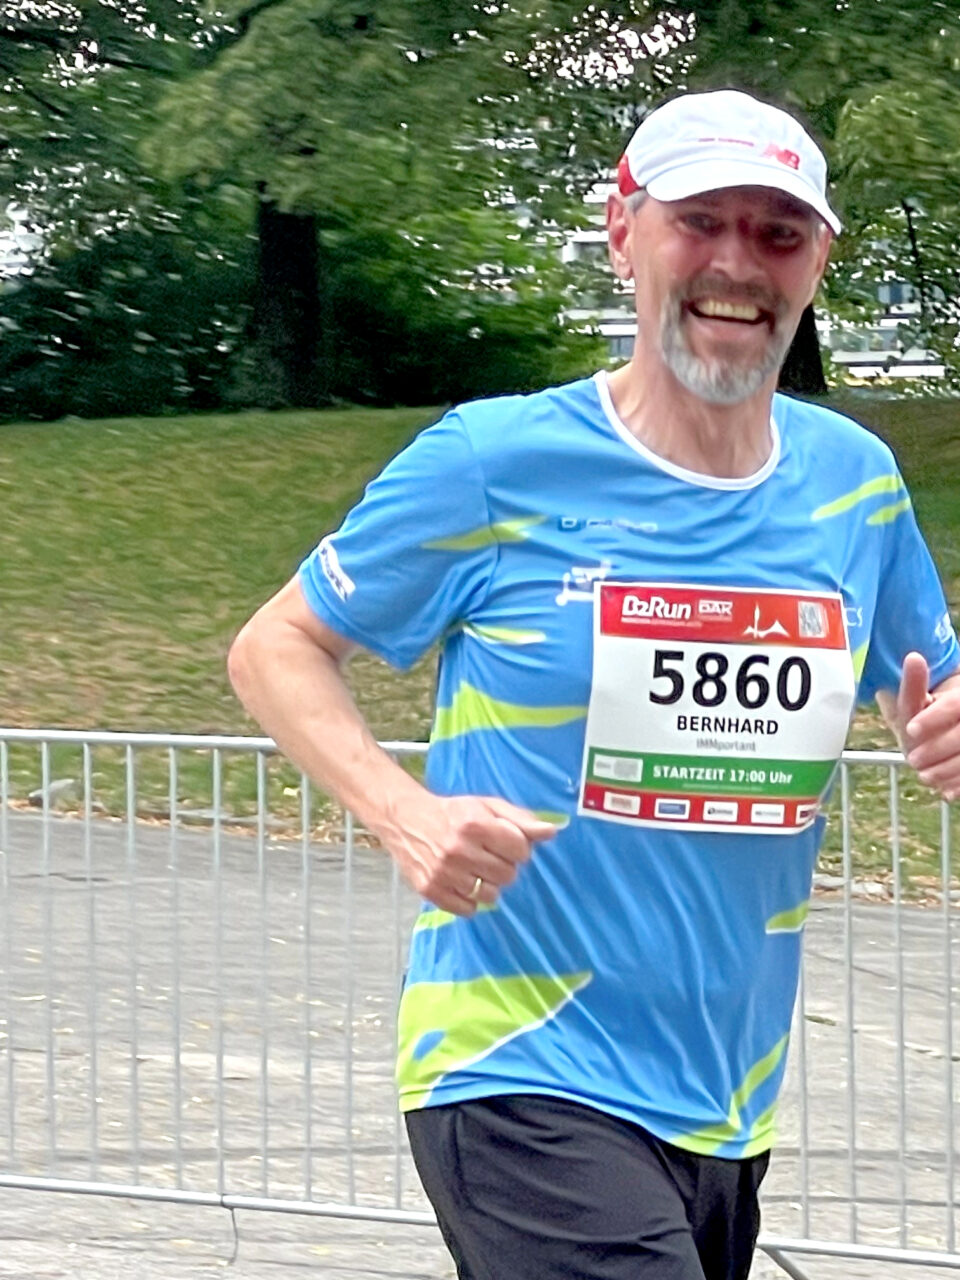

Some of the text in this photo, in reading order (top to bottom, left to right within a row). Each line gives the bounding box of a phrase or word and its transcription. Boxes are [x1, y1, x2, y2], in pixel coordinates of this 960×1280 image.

[621, 594, 692, 619] B2Run
[649, 649, 812, 712] 5860
[676, 715, 779, 736] BERNHARD
[653, 765, 725, 782] STARTZEIT
[730, 769, 766, 783] 17:00
[769, 771, 793, 784] Uhr
